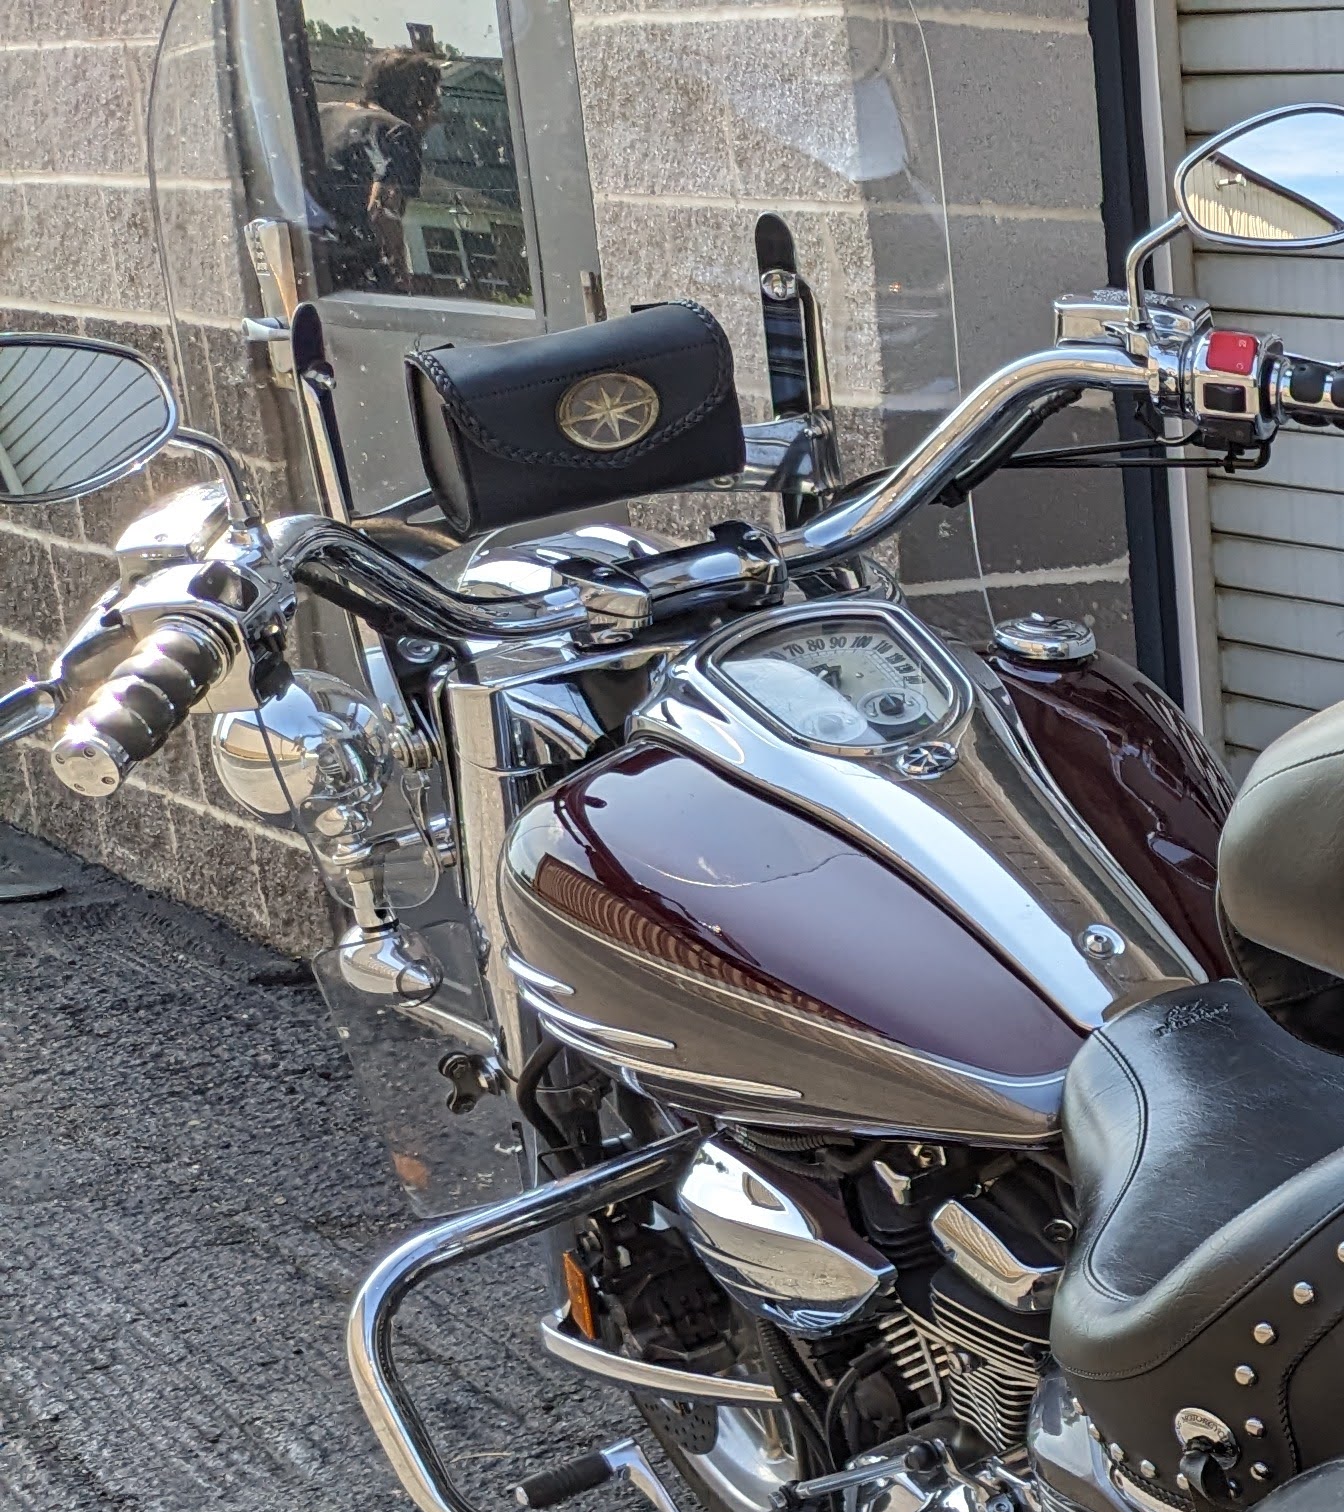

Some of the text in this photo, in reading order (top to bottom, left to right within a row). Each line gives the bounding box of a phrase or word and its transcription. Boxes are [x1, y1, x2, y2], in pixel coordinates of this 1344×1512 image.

[783, 643, 805, 657] 70
[806, 638, 826, 652] 80
[829, 636, 848, 649] 90
[850, 635, 873, 649] 100
